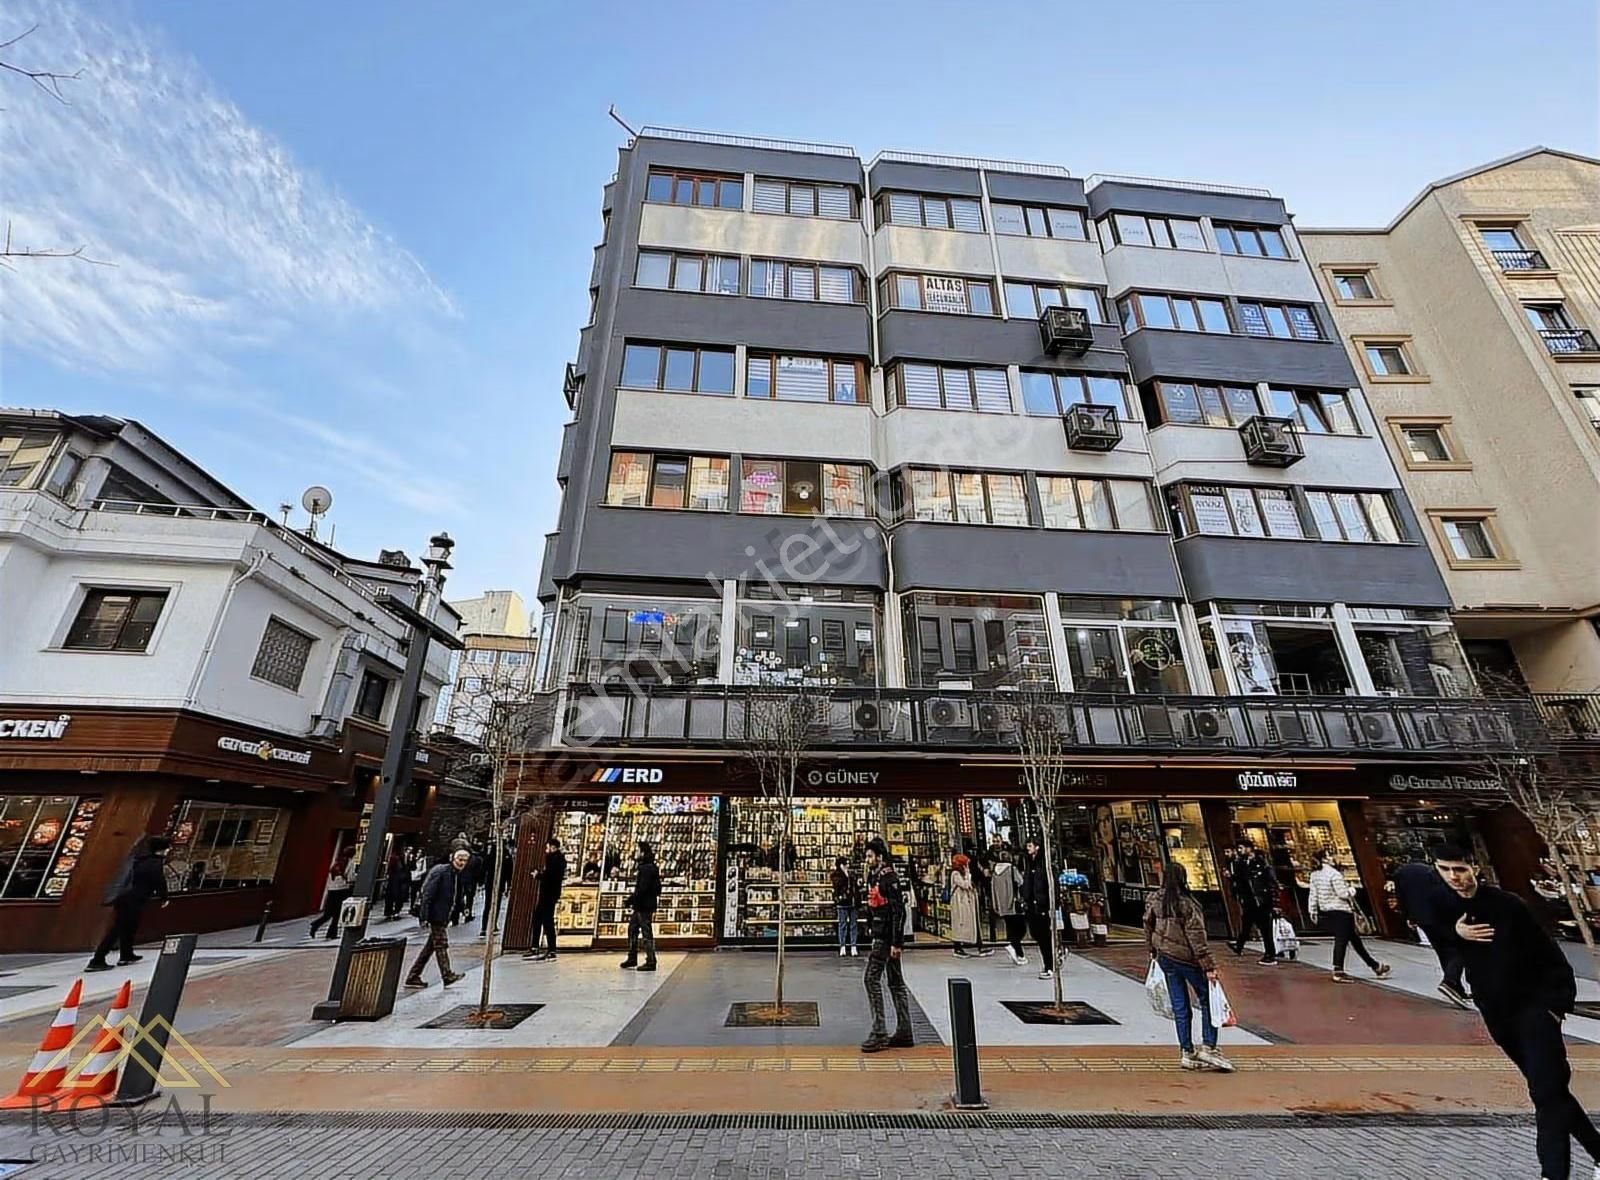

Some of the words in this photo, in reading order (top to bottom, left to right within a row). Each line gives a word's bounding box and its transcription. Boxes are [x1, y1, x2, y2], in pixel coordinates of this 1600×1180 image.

[622, 768, 663, 783] ERD
[825, 768, 879, 784] GÜNEY
[1239, 771, 1276, 790] gözüm
